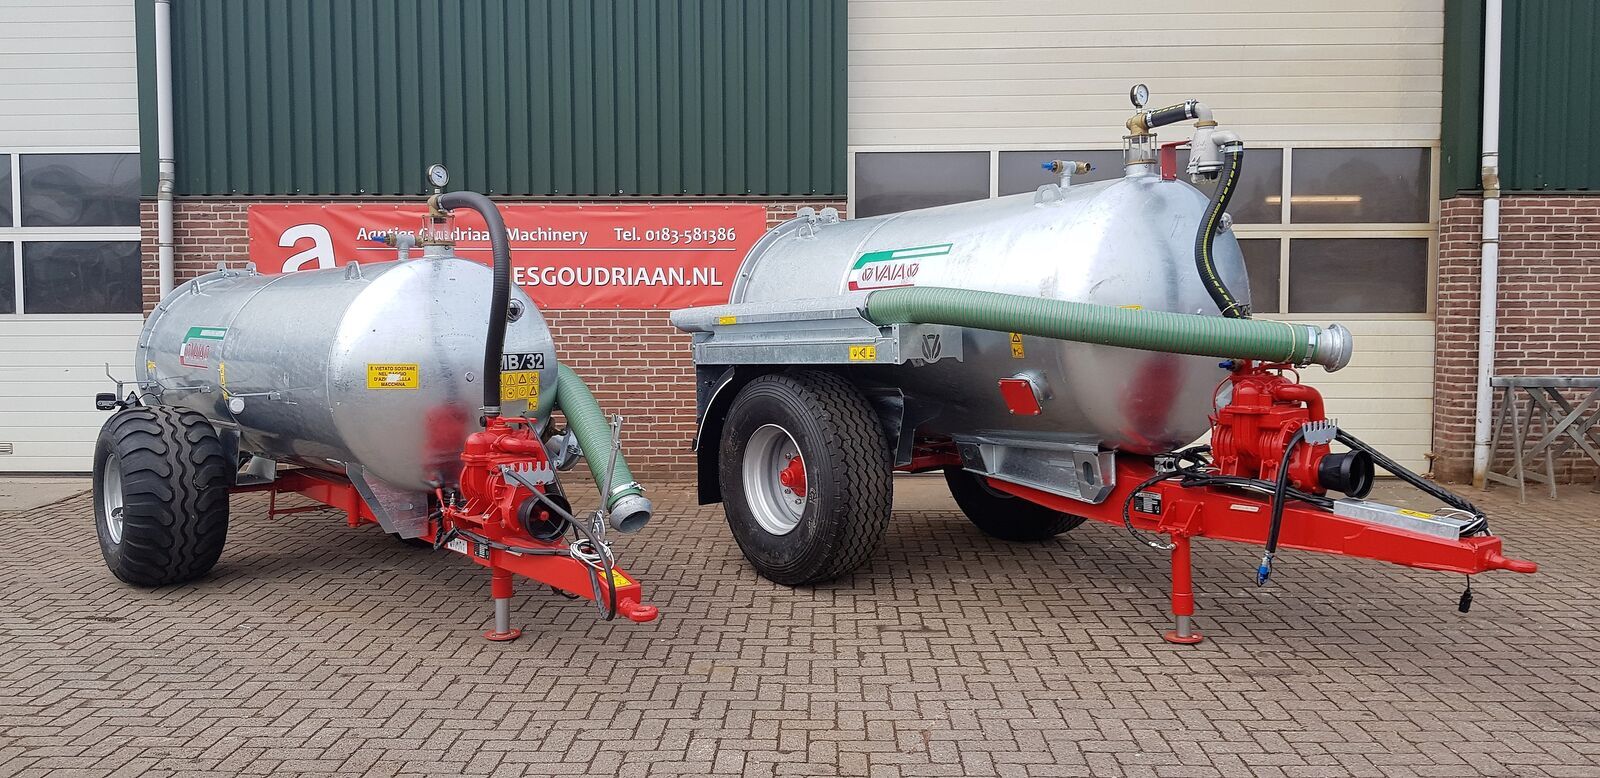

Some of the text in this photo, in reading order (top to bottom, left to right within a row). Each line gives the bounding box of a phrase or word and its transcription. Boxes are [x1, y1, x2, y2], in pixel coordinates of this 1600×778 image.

[505, 226, 588, 245] Machinery
[613, 226, 641, 242] Tel.
[645, 227, 737, 245] 0183-581386
